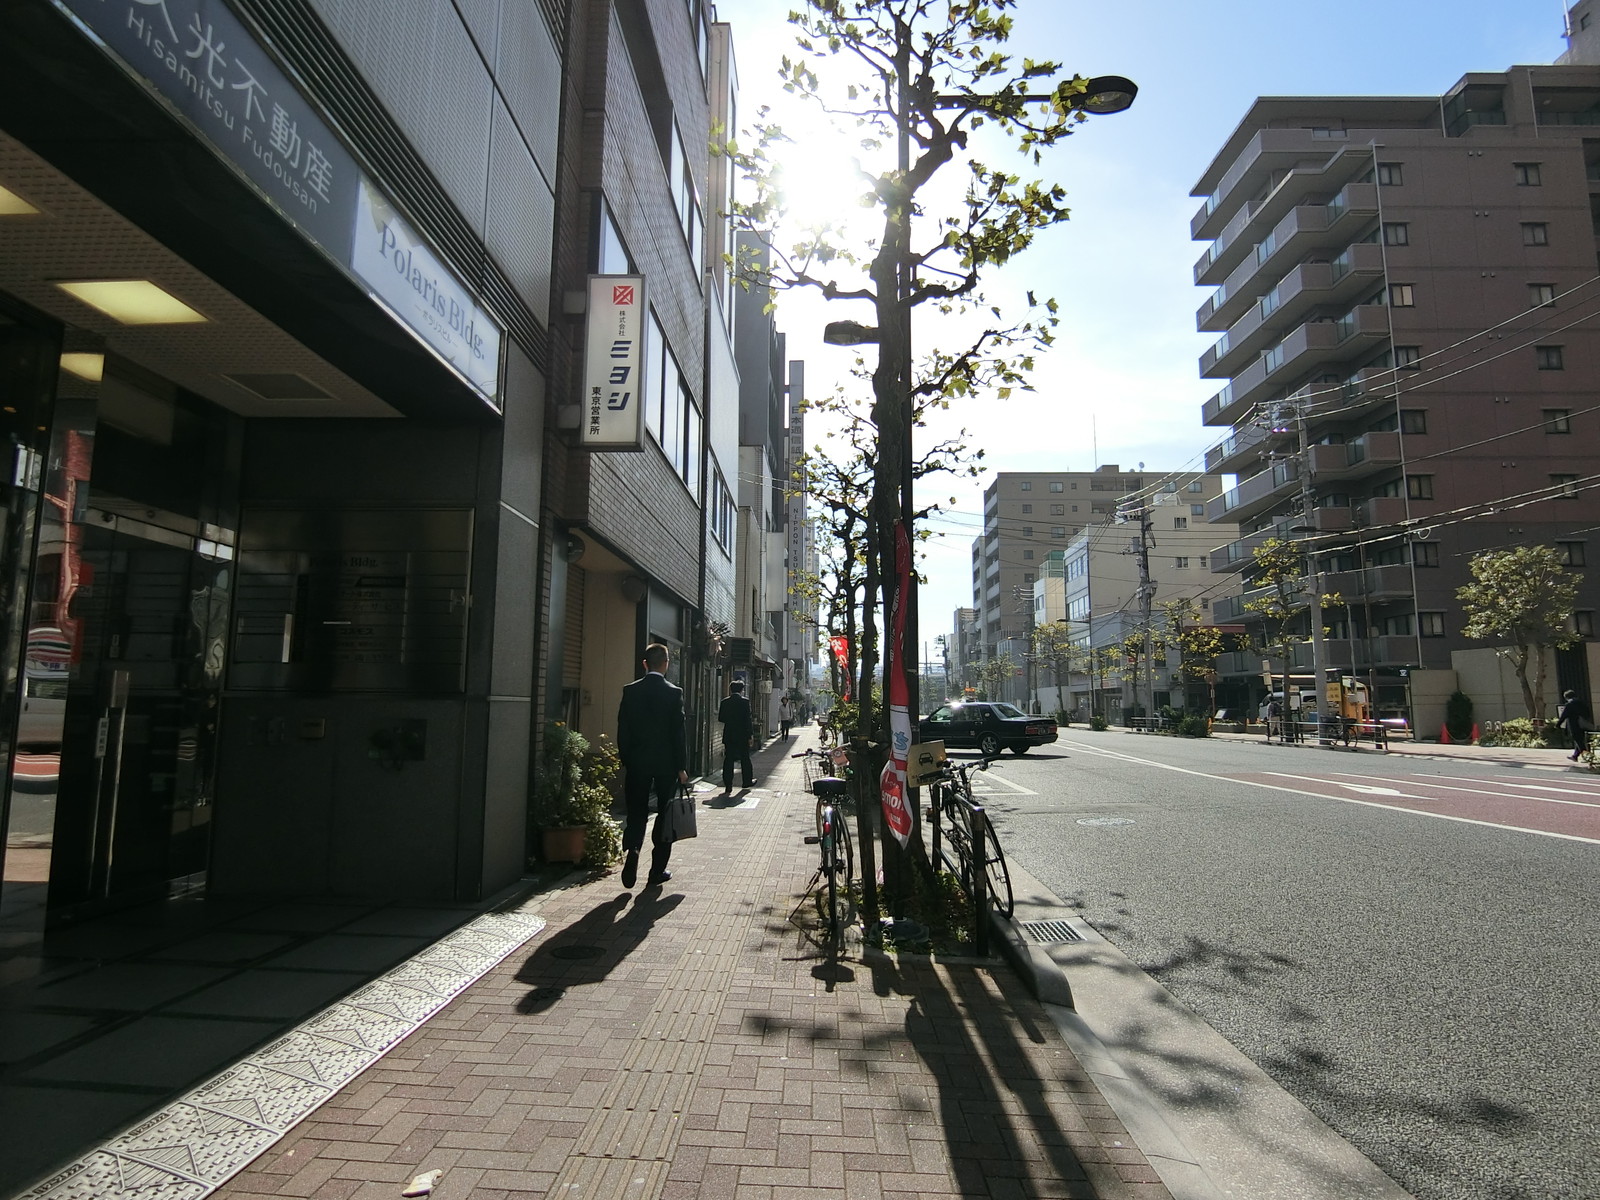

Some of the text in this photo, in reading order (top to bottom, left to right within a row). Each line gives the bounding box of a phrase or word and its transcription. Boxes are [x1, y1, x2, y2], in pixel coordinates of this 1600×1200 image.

[127, 7, 318, 216] Hisamitsu Fudousan
[379, 221, 486, 361] Polaris Bldg.
[589, 386, 602, 435] 東京営業所
[607, 310, 633, 411] 株式会社 ミヨシ
